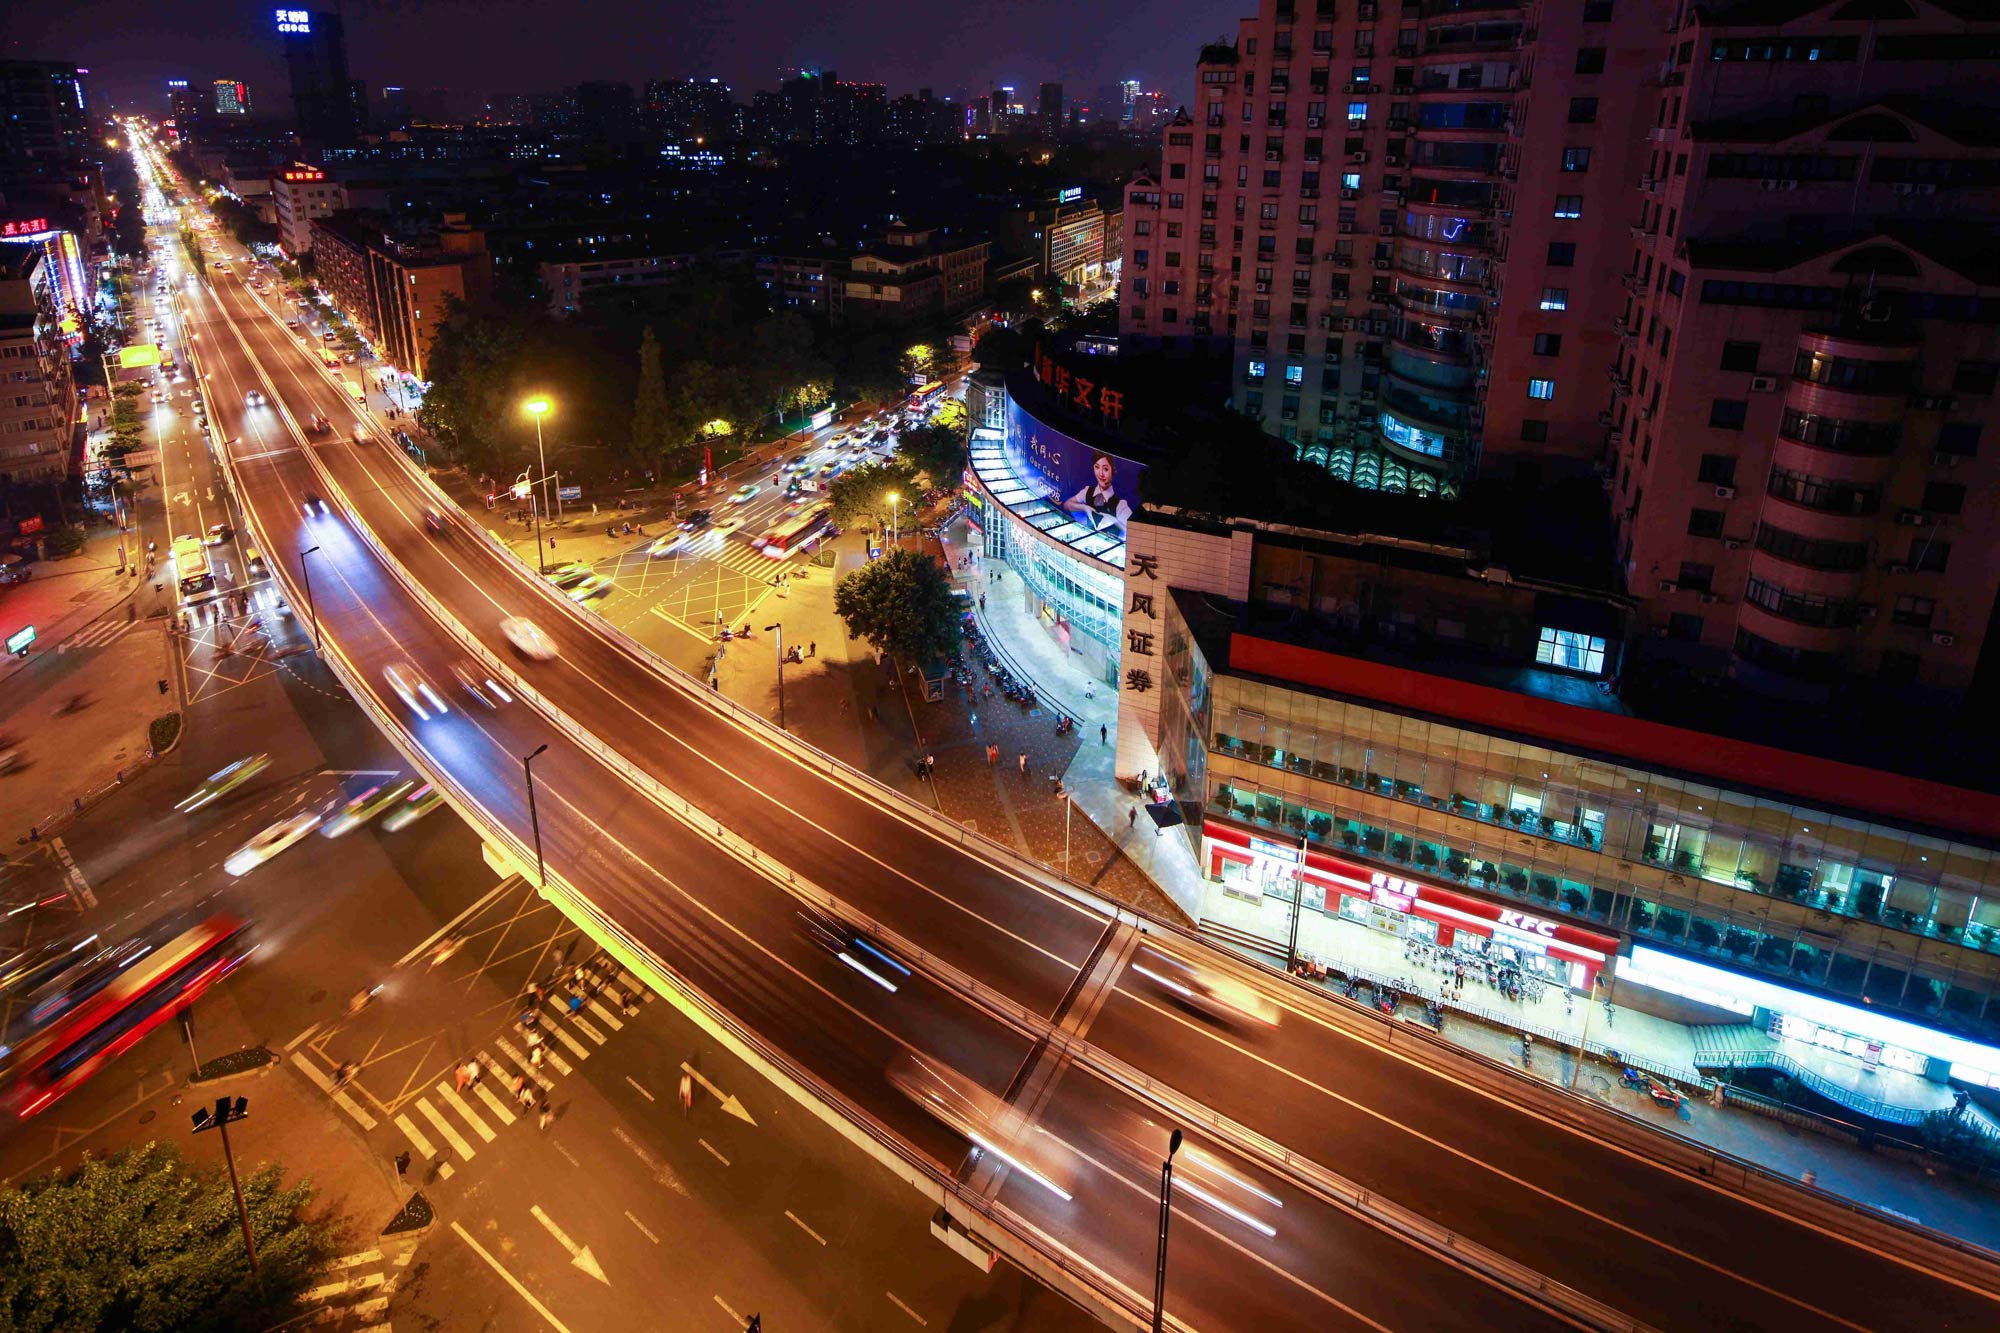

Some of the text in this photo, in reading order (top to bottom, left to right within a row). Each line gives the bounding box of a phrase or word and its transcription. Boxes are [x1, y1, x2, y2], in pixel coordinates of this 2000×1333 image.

[1029, 455, 1041, 470] Our
[1042, 465, 1060, 482] Care
[1125, 552, 1158, 693] 天风证券
[1498, 909, 1557, 937] KFC
